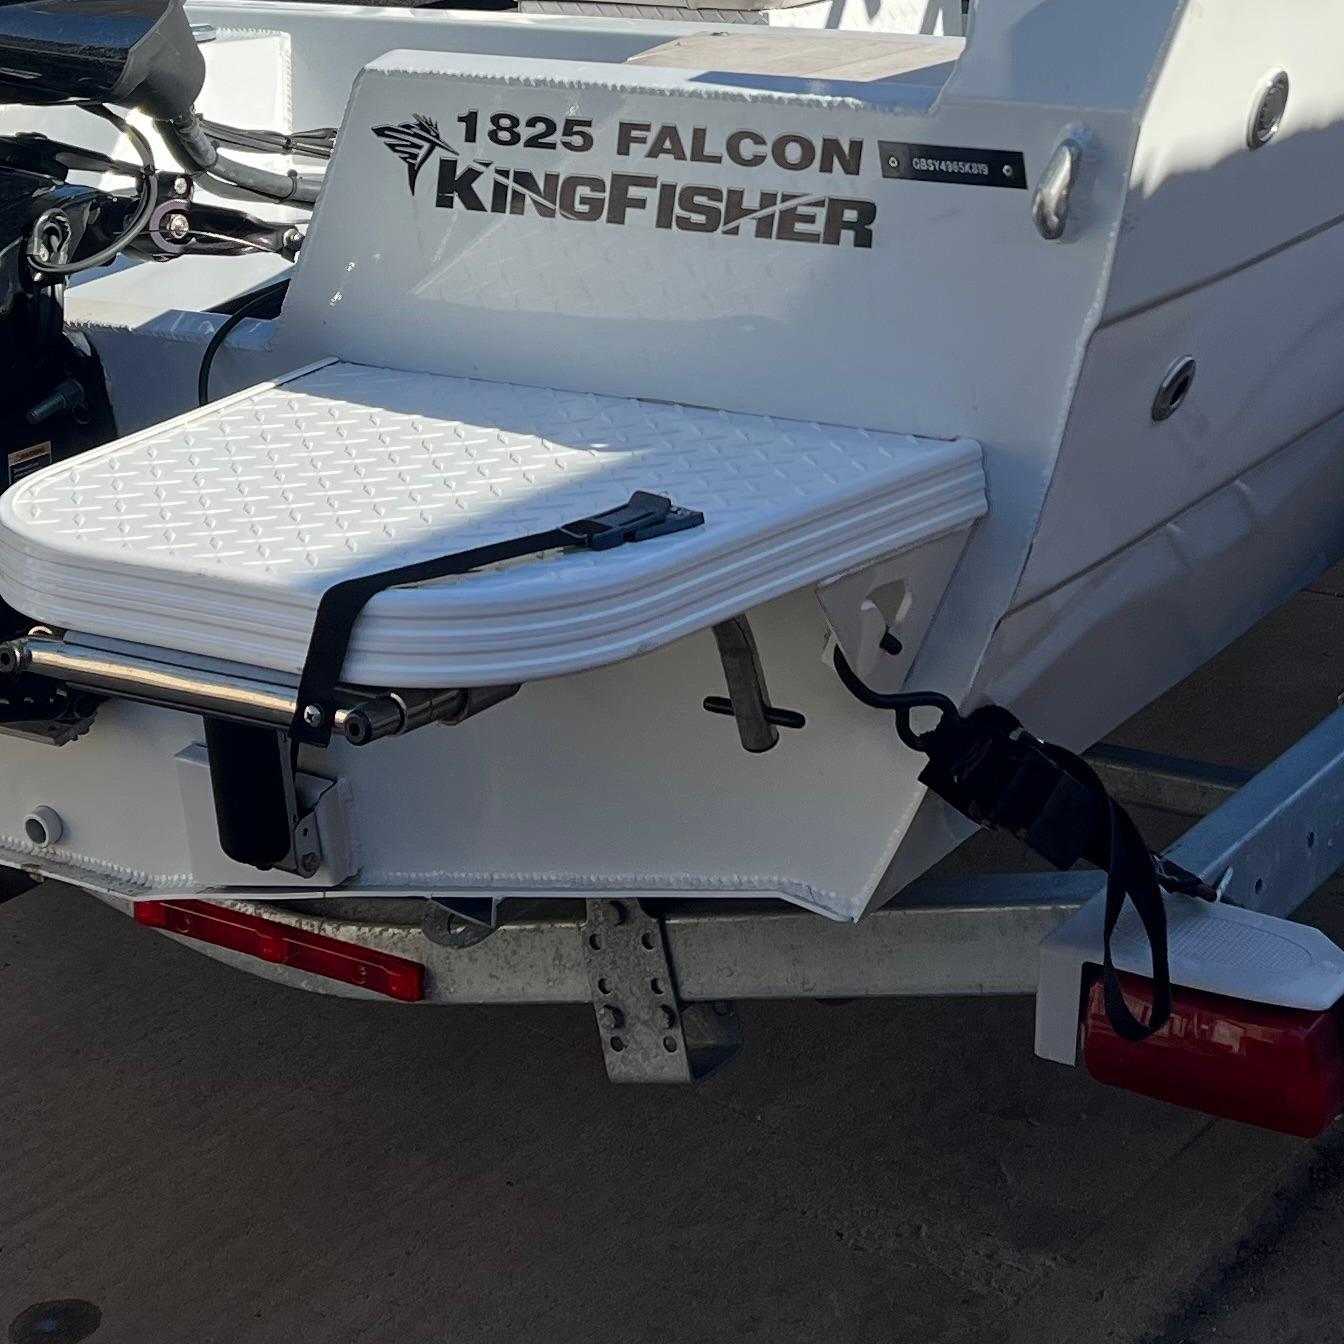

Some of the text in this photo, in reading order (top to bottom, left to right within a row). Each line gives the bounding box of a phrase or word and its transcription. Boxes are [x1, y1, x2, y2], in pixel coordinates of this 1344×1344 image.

[457, 109, 864, 176] 1825 FALCON
[435, 156, 878, 249] KINGFISHER
